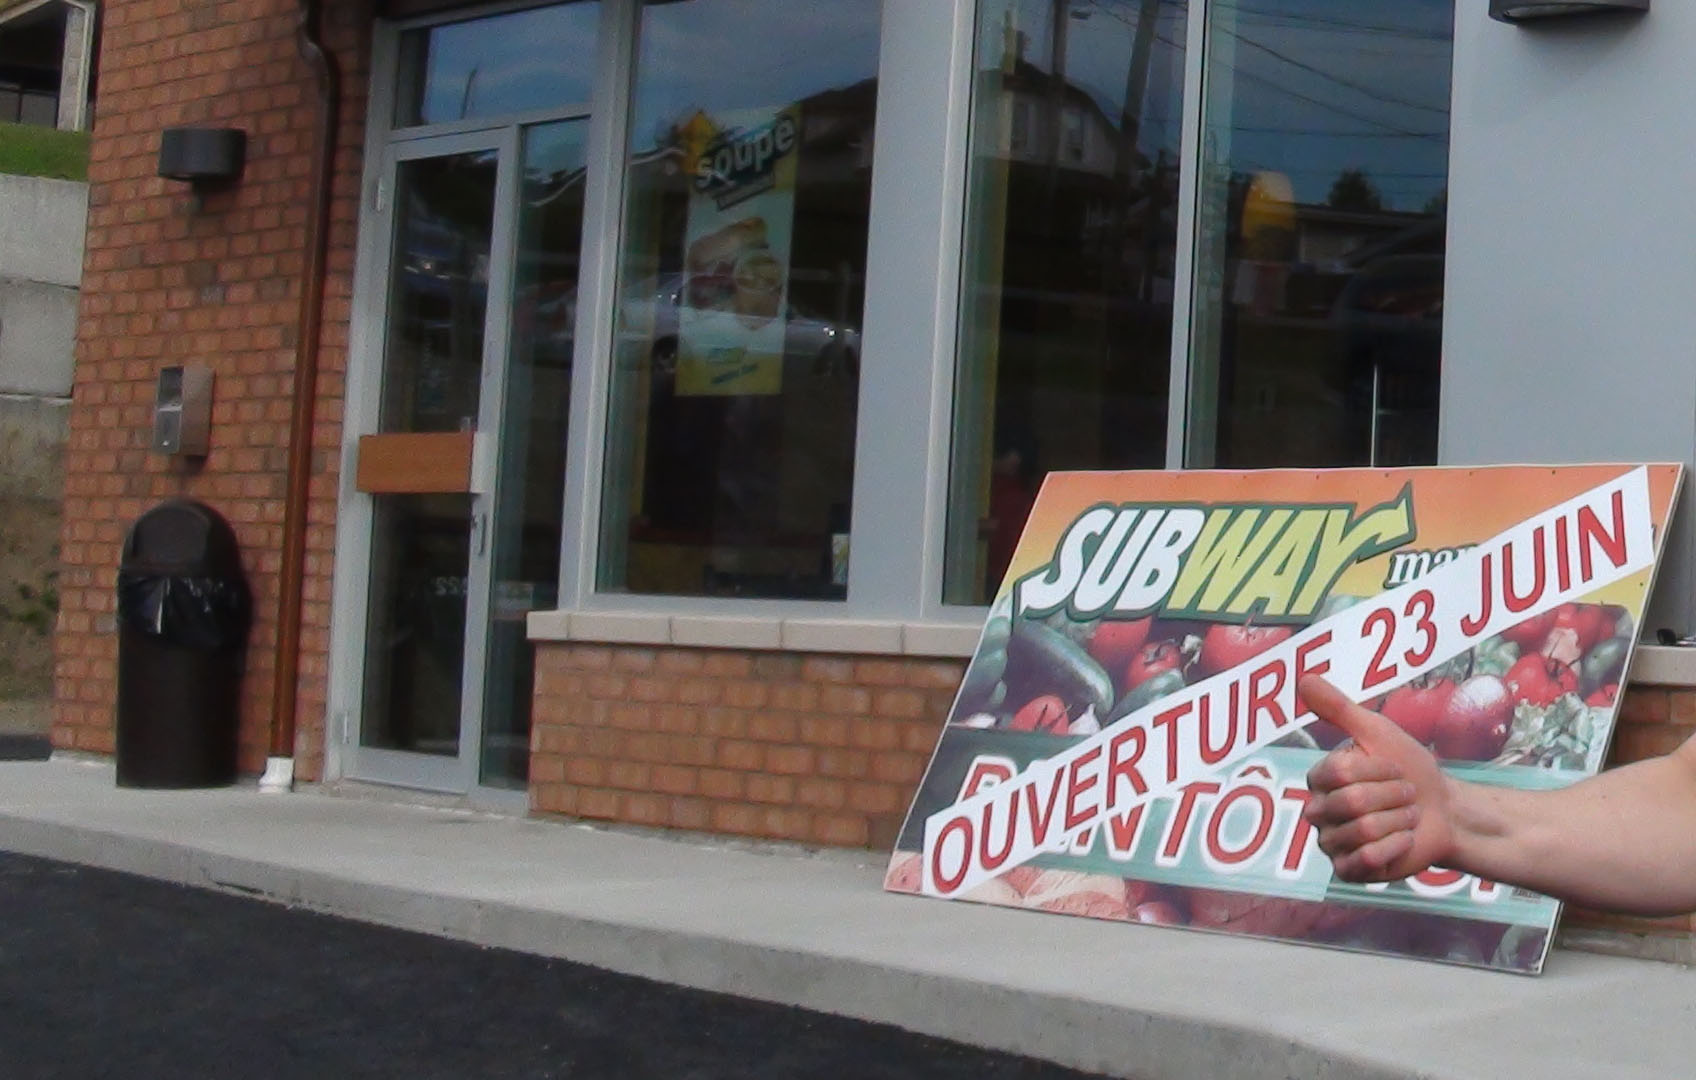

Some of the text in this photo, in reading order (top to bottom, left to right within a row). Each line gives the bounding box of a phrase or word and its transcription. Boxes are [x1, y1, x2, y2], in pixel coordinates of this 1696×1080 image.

[1017, 497, 1411, 618] SUBWAY
[931, 488, 1628, 896] OUVERTURE 23 JUIN
